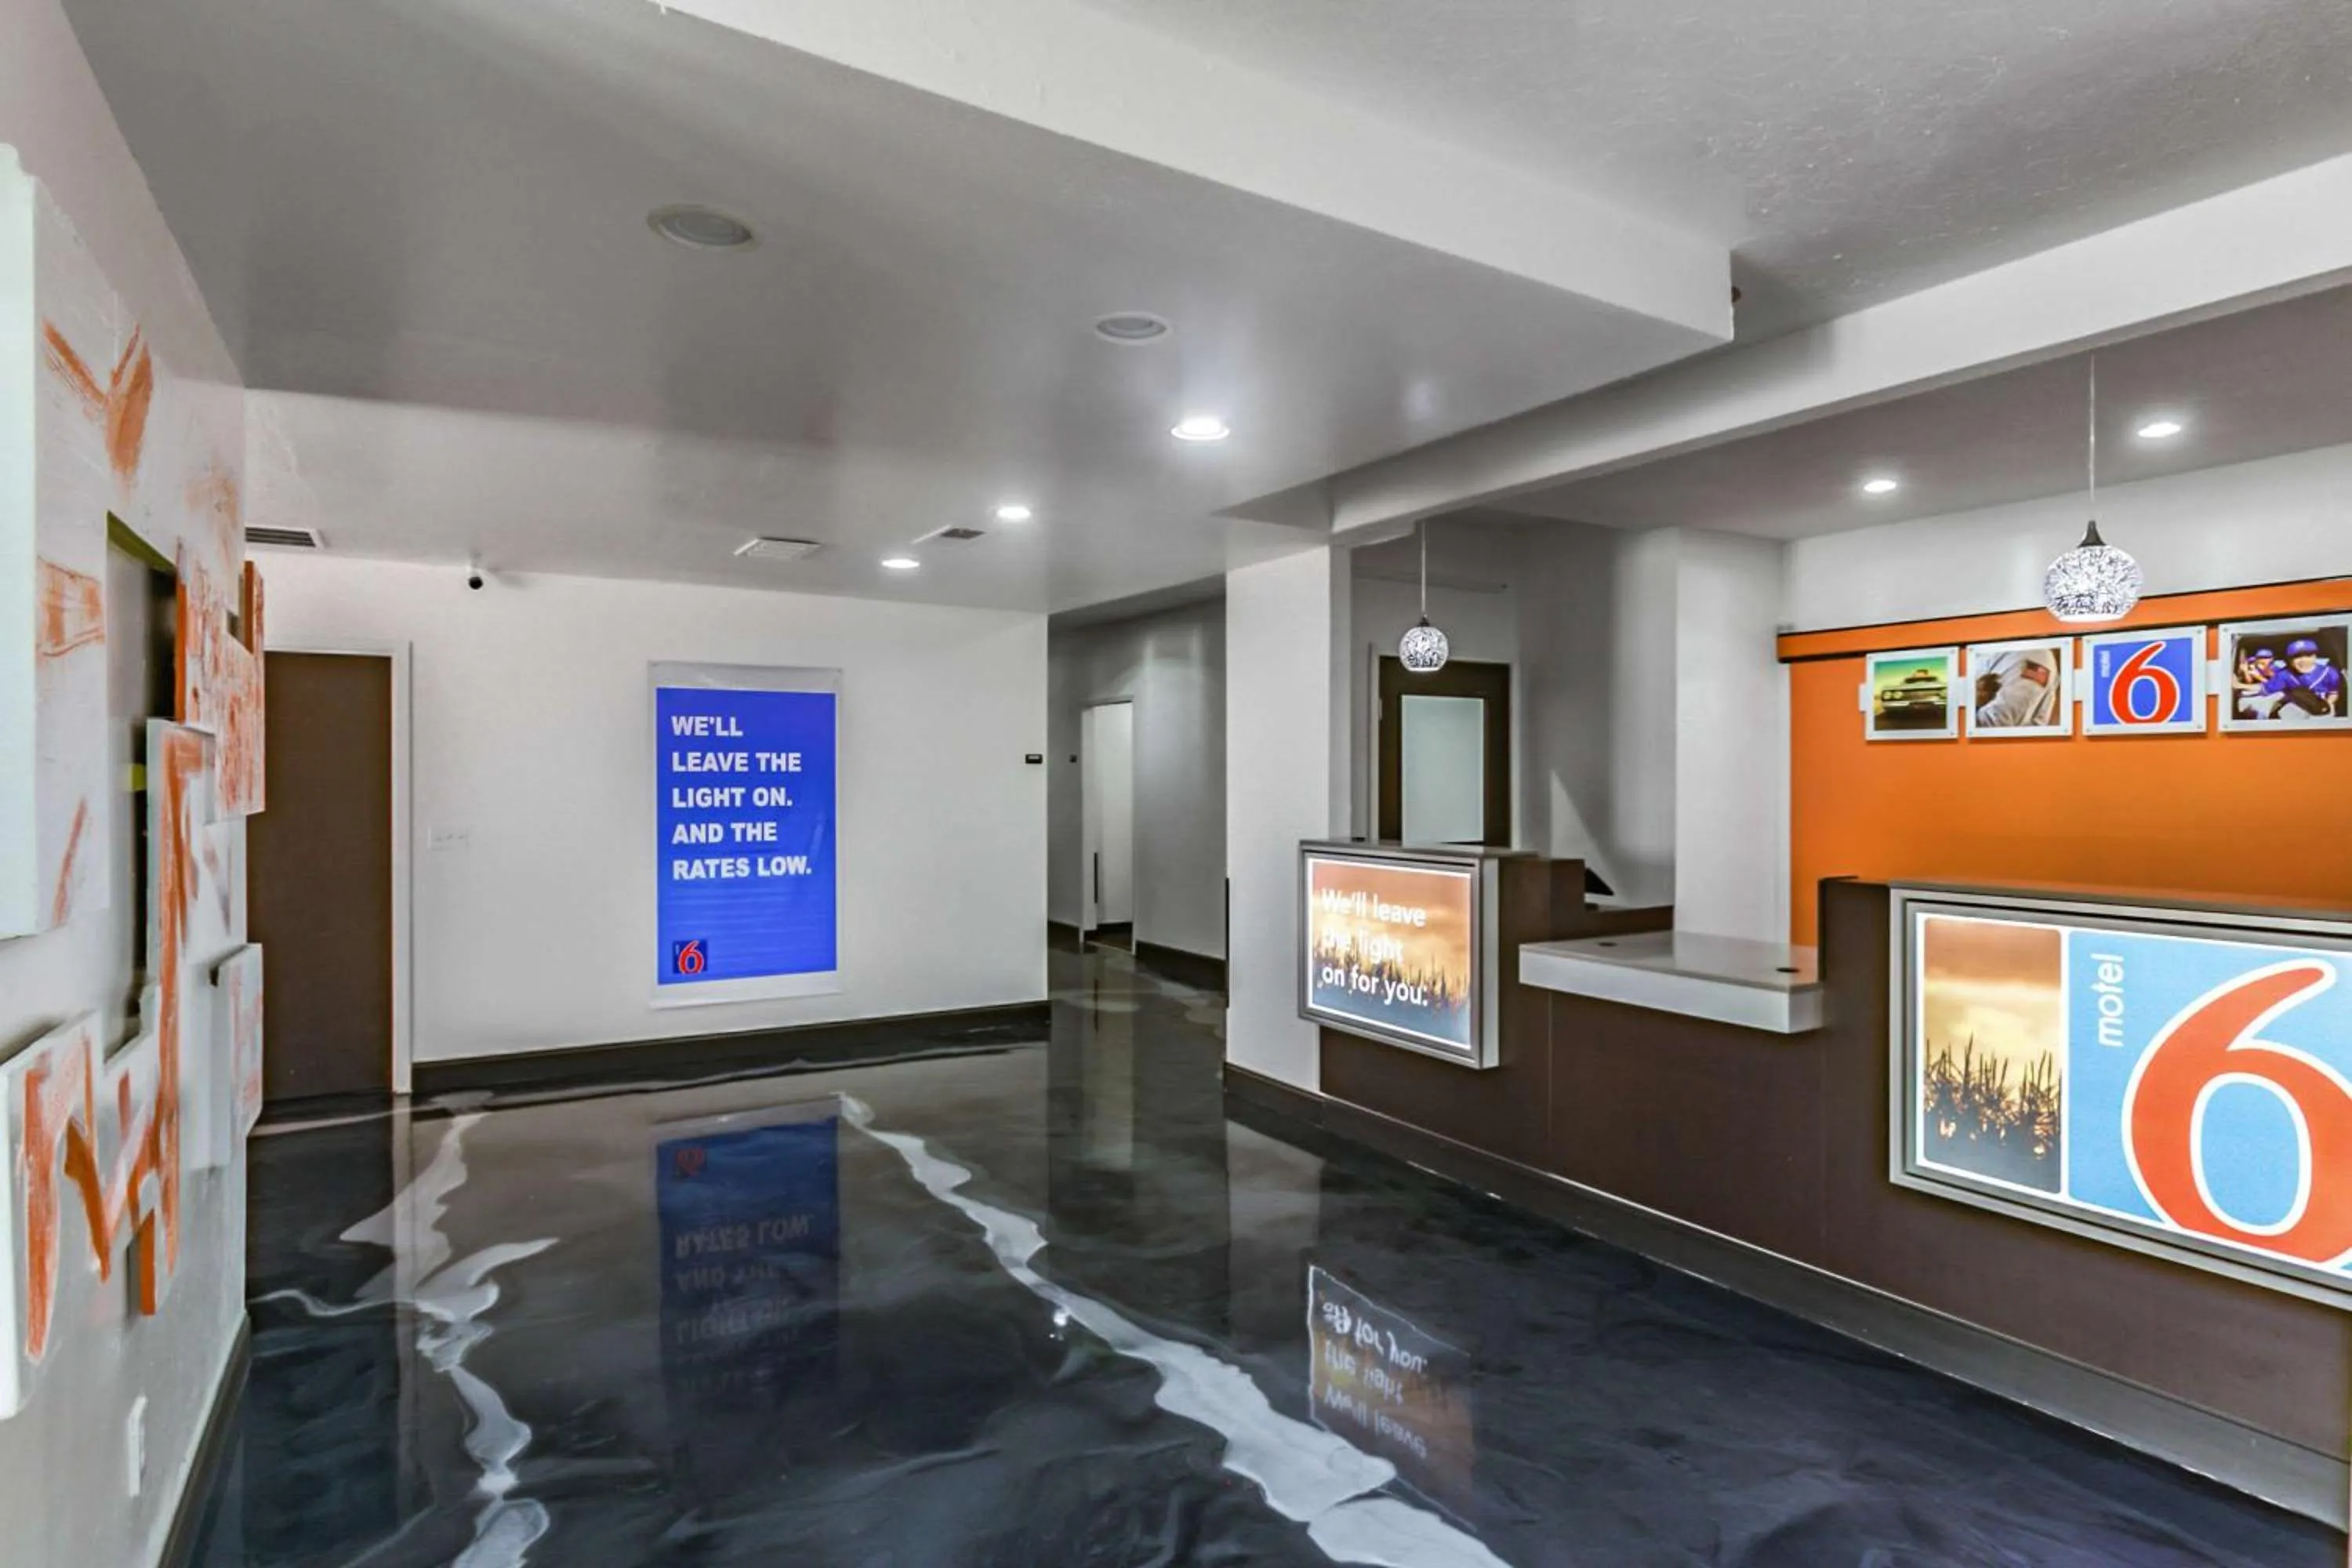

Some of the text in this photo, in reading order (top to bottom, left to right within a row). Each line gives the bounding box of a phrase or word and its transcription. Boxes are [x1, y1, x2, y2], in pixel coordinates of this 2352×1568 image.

[2108, 641, 2180, 724] 6
[672, 716, 743, 737] WE'LL
[672, 752, 801, 772] LEAVE THE
[672, 787, 793, 808] LIGHT ON.
[672, 822, 777, 844] AND THE
[673, 855, 812, 880] RATES LOW.
[1321, 887, 1427, 927] We'll leave
[677, 940, 704, 975] 6
[1359, 927, 1403, 964] light
[1322, 966, 1345, 987] on
[1351, 964, 1379, 994] for
[2089, 953, 2125, 1047] motel
[2121, 956, 2352, 1268] 6
